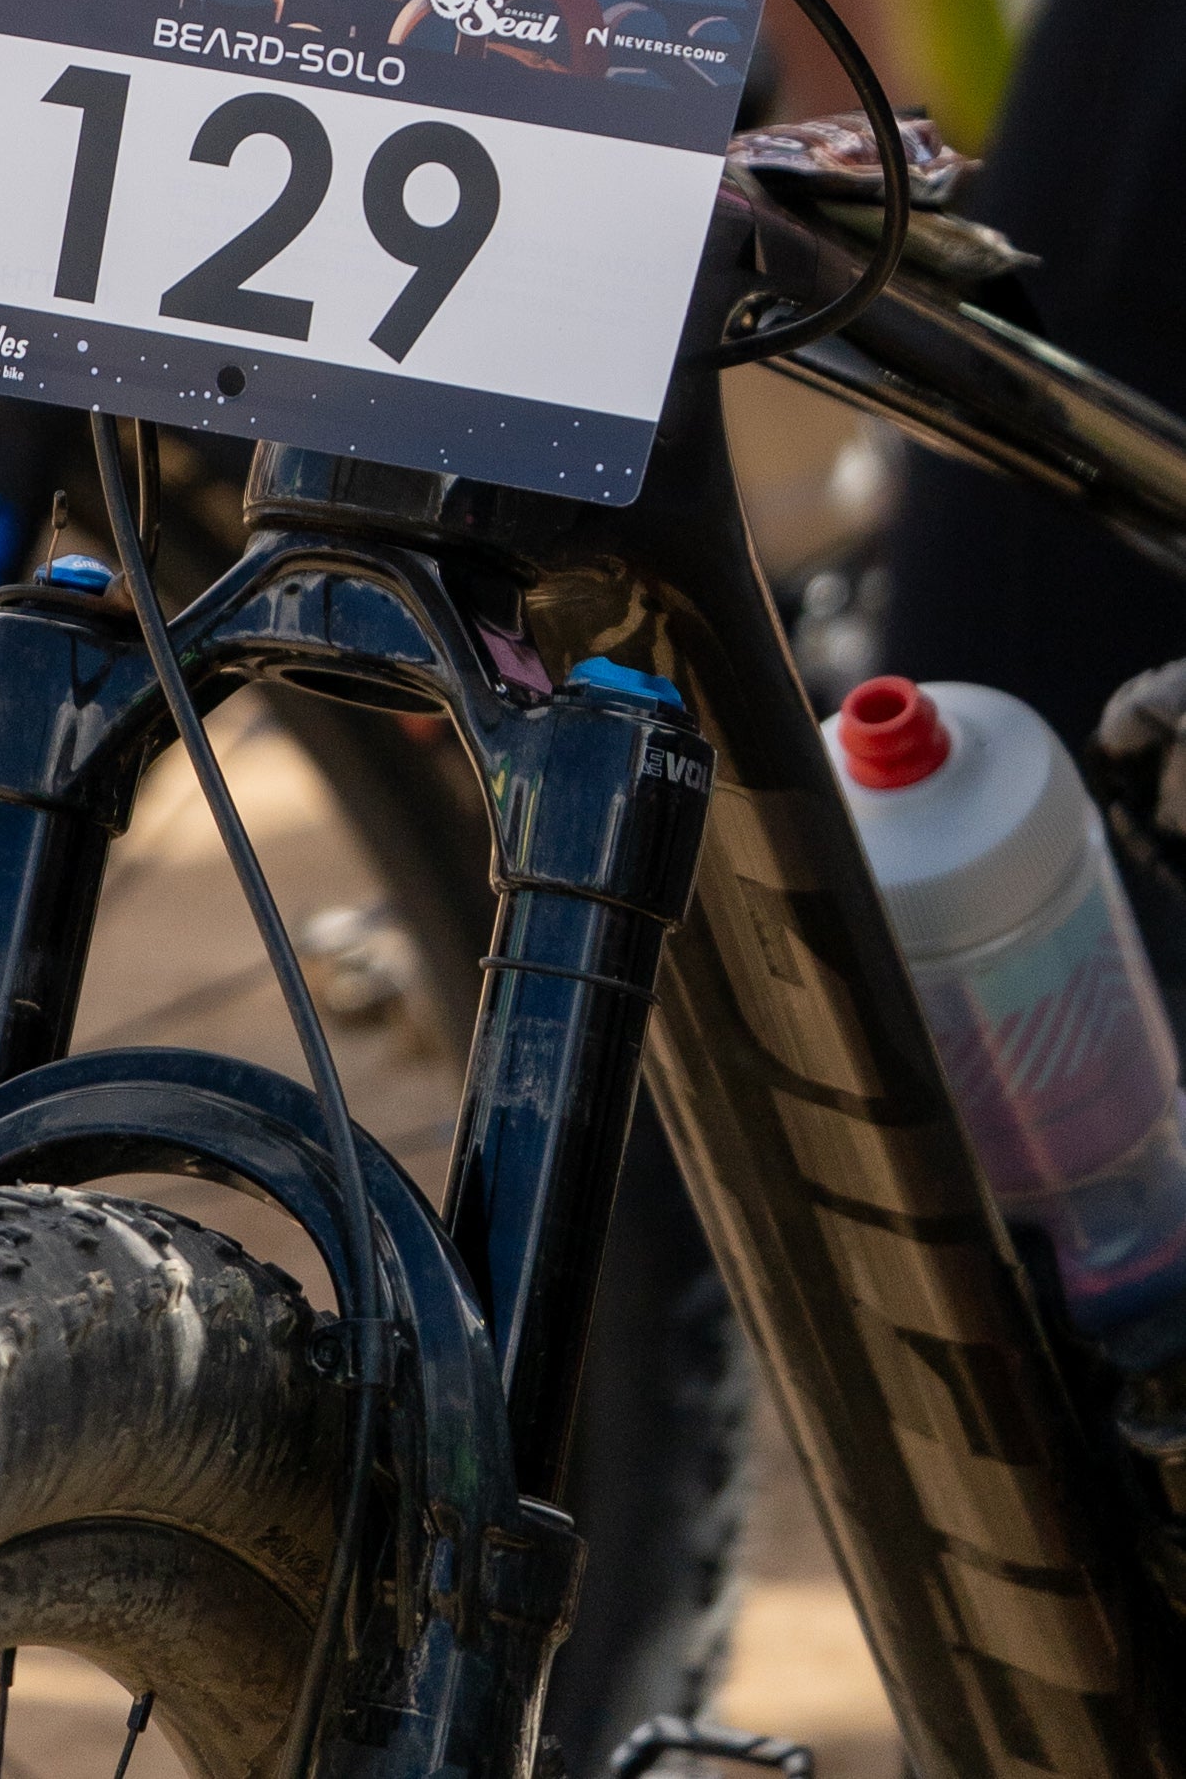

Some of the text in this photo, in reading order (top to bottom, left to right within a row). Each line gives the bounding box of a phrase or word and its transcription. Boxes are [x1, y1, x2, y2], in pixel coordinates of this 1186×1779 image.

[504, 7, 545, 21] ORANGE
[153, 17, 406, 87] BEARD-SOLO
[613, 34, 727, 63] NEVERSECOND
[39, 64, 501, 364] 129
[2, 365, 25, 381] bike
